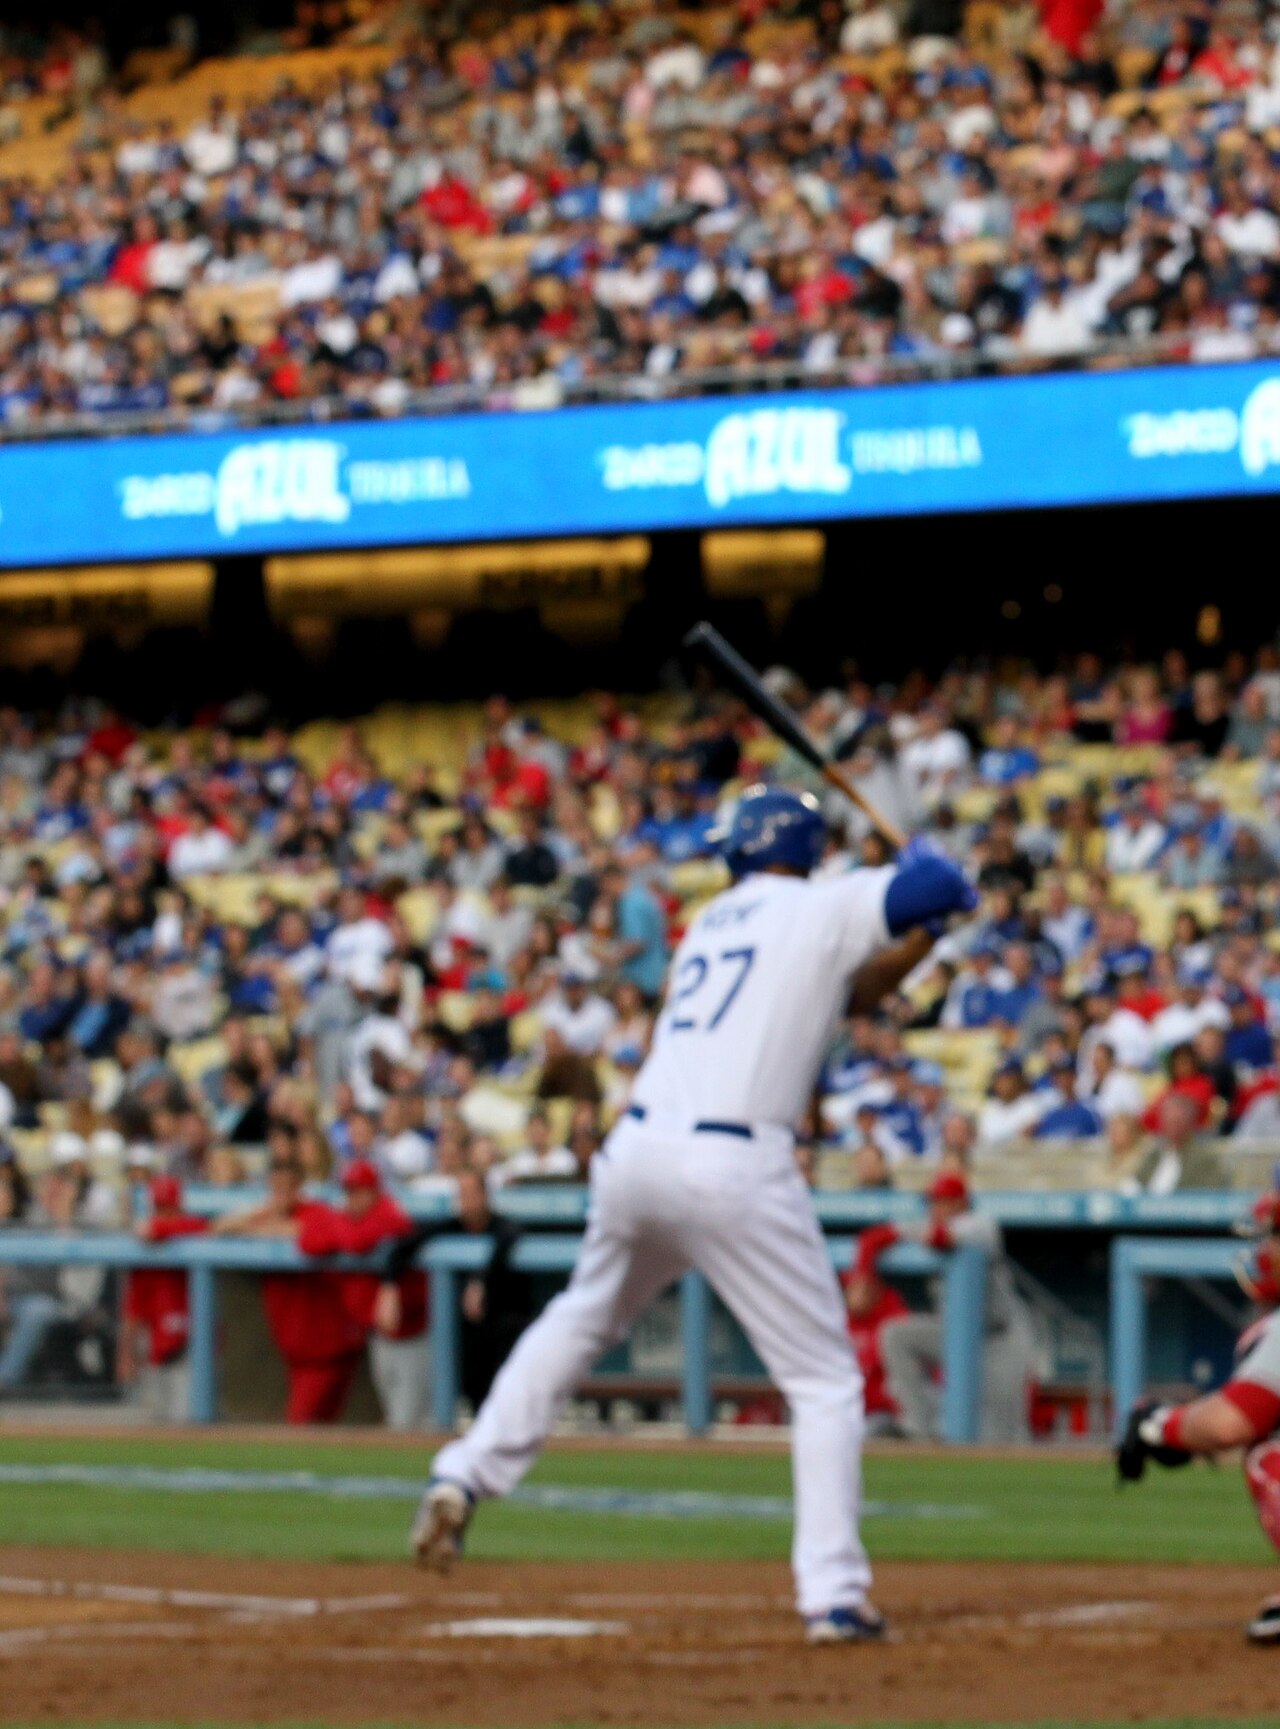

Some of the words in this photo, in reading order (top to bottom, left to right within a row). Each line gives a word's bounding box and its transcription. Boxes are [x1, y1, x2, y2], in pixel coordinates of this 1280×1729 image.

[214, 438, 351, 536] AZUL
[704, 406, 853, 508] AZUL
[670, 946, 757, 1031] 27
